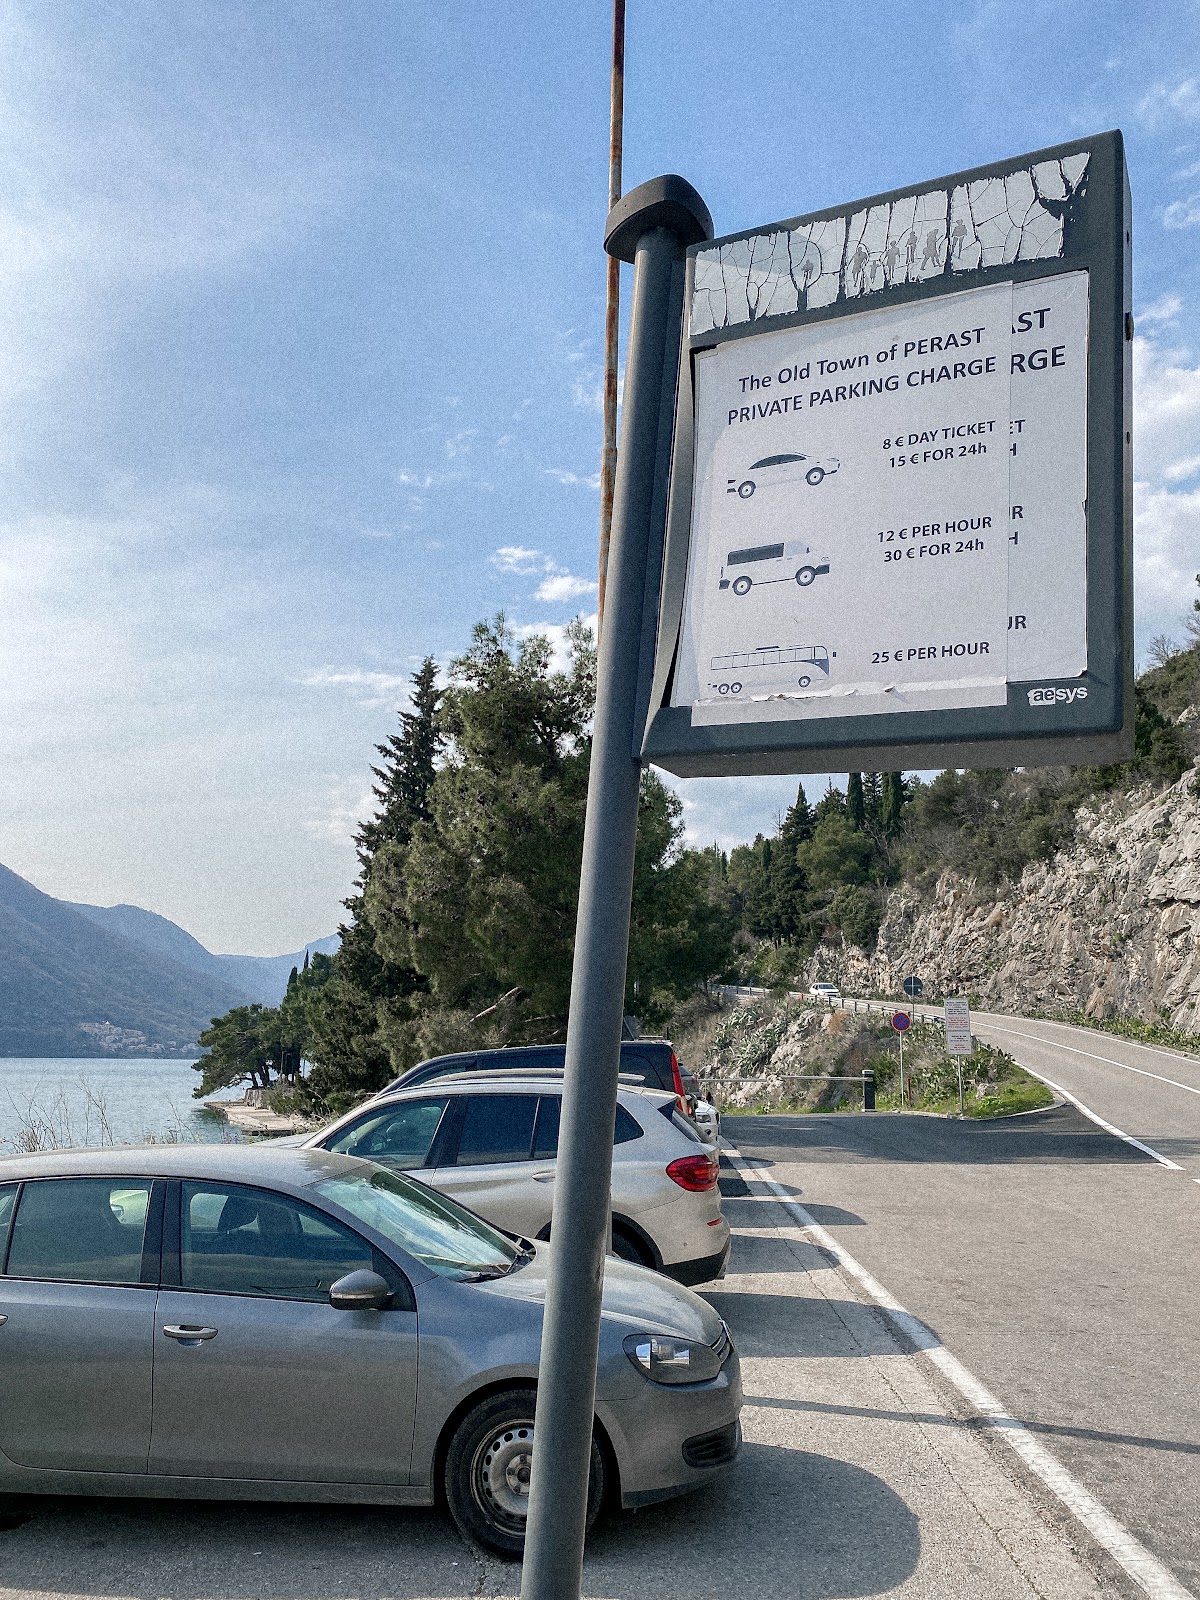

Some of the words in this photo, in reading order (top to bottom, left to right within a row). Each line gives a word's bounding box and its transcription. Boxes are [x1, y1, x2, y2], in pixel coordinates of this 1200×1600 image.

[1011, 307, 1051, 335] ST
[738, 374, 772, 393] The
[777, 363, 811, 384] Old
[816, 354, 869, 376] Town
[876, 343, 898, 363] of
[904, 327, 986, 358] PERAST
[1010, 344, 1066, 375] RGE
[728, 394, 803, 426] PRIVATE
[808, 373, 899, 407] PARKING
[906, 356, 996, 387] CHARGE
[882, 438, 892, 450] 8
[894, 436, 904, 448] €
[908, 429, 939, 446] DAY
[941, 420, 996, 440] TICKET
[889, 455, 906, 468] 15
[909, 453, 919, 465] €
[923, 447, 954, 463] FOR
[958, 442, 987, 457] 24h
[878, 530, 895, 543] 12
[898, 528, 908, 540] €
[912, 523, 941, 538] PER
[945, 516, 992, 534] HOUR
[884, 549, 902, 563] 30
[906, 547, 915, 559] €
[919, 542, 951, 558] FOR
[955, 538, 984, 553] 24h
[871, 651, 890, 664] 25
[893, 649, 903, 662] €
[907, 646, 937, 661] PER
[941, 641, 990, 658] HOUR
[1031, 687, 1088, 704] aesys
